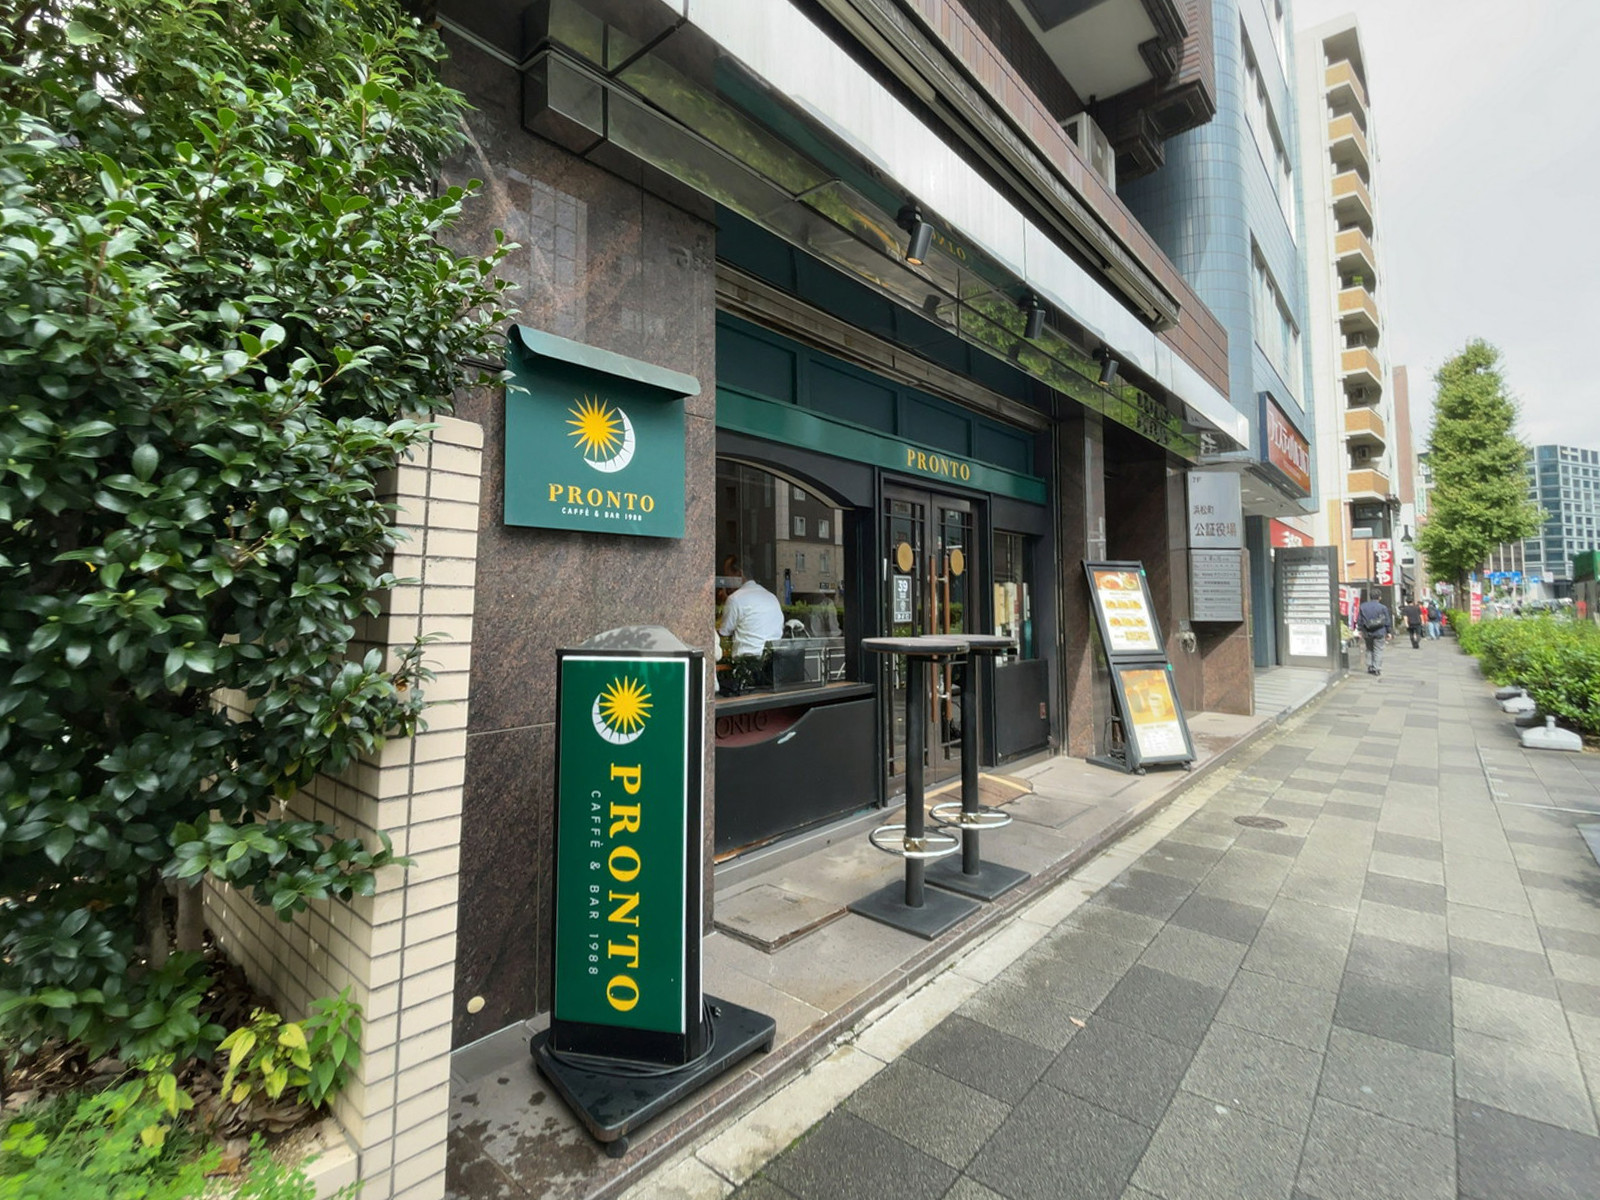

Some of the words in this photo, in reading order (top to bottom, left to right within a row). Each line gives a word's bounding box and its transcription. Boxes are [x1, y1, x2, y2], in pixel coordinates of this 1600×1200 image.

[906, 448, 971, 481] PRONTO
[548, 483, 655, 513] PRONTO
[604, 511, 621, 519] BAR
[624, 513, 643, 522] 1988
[1194, 522, 1237, 537] 公証役場
[590, 861, 602, 870] &
[589, 884, 600, 920] BAR
[606, 762, 642, 1013] PRONTO
[588, 933, 599, 976] 1988
